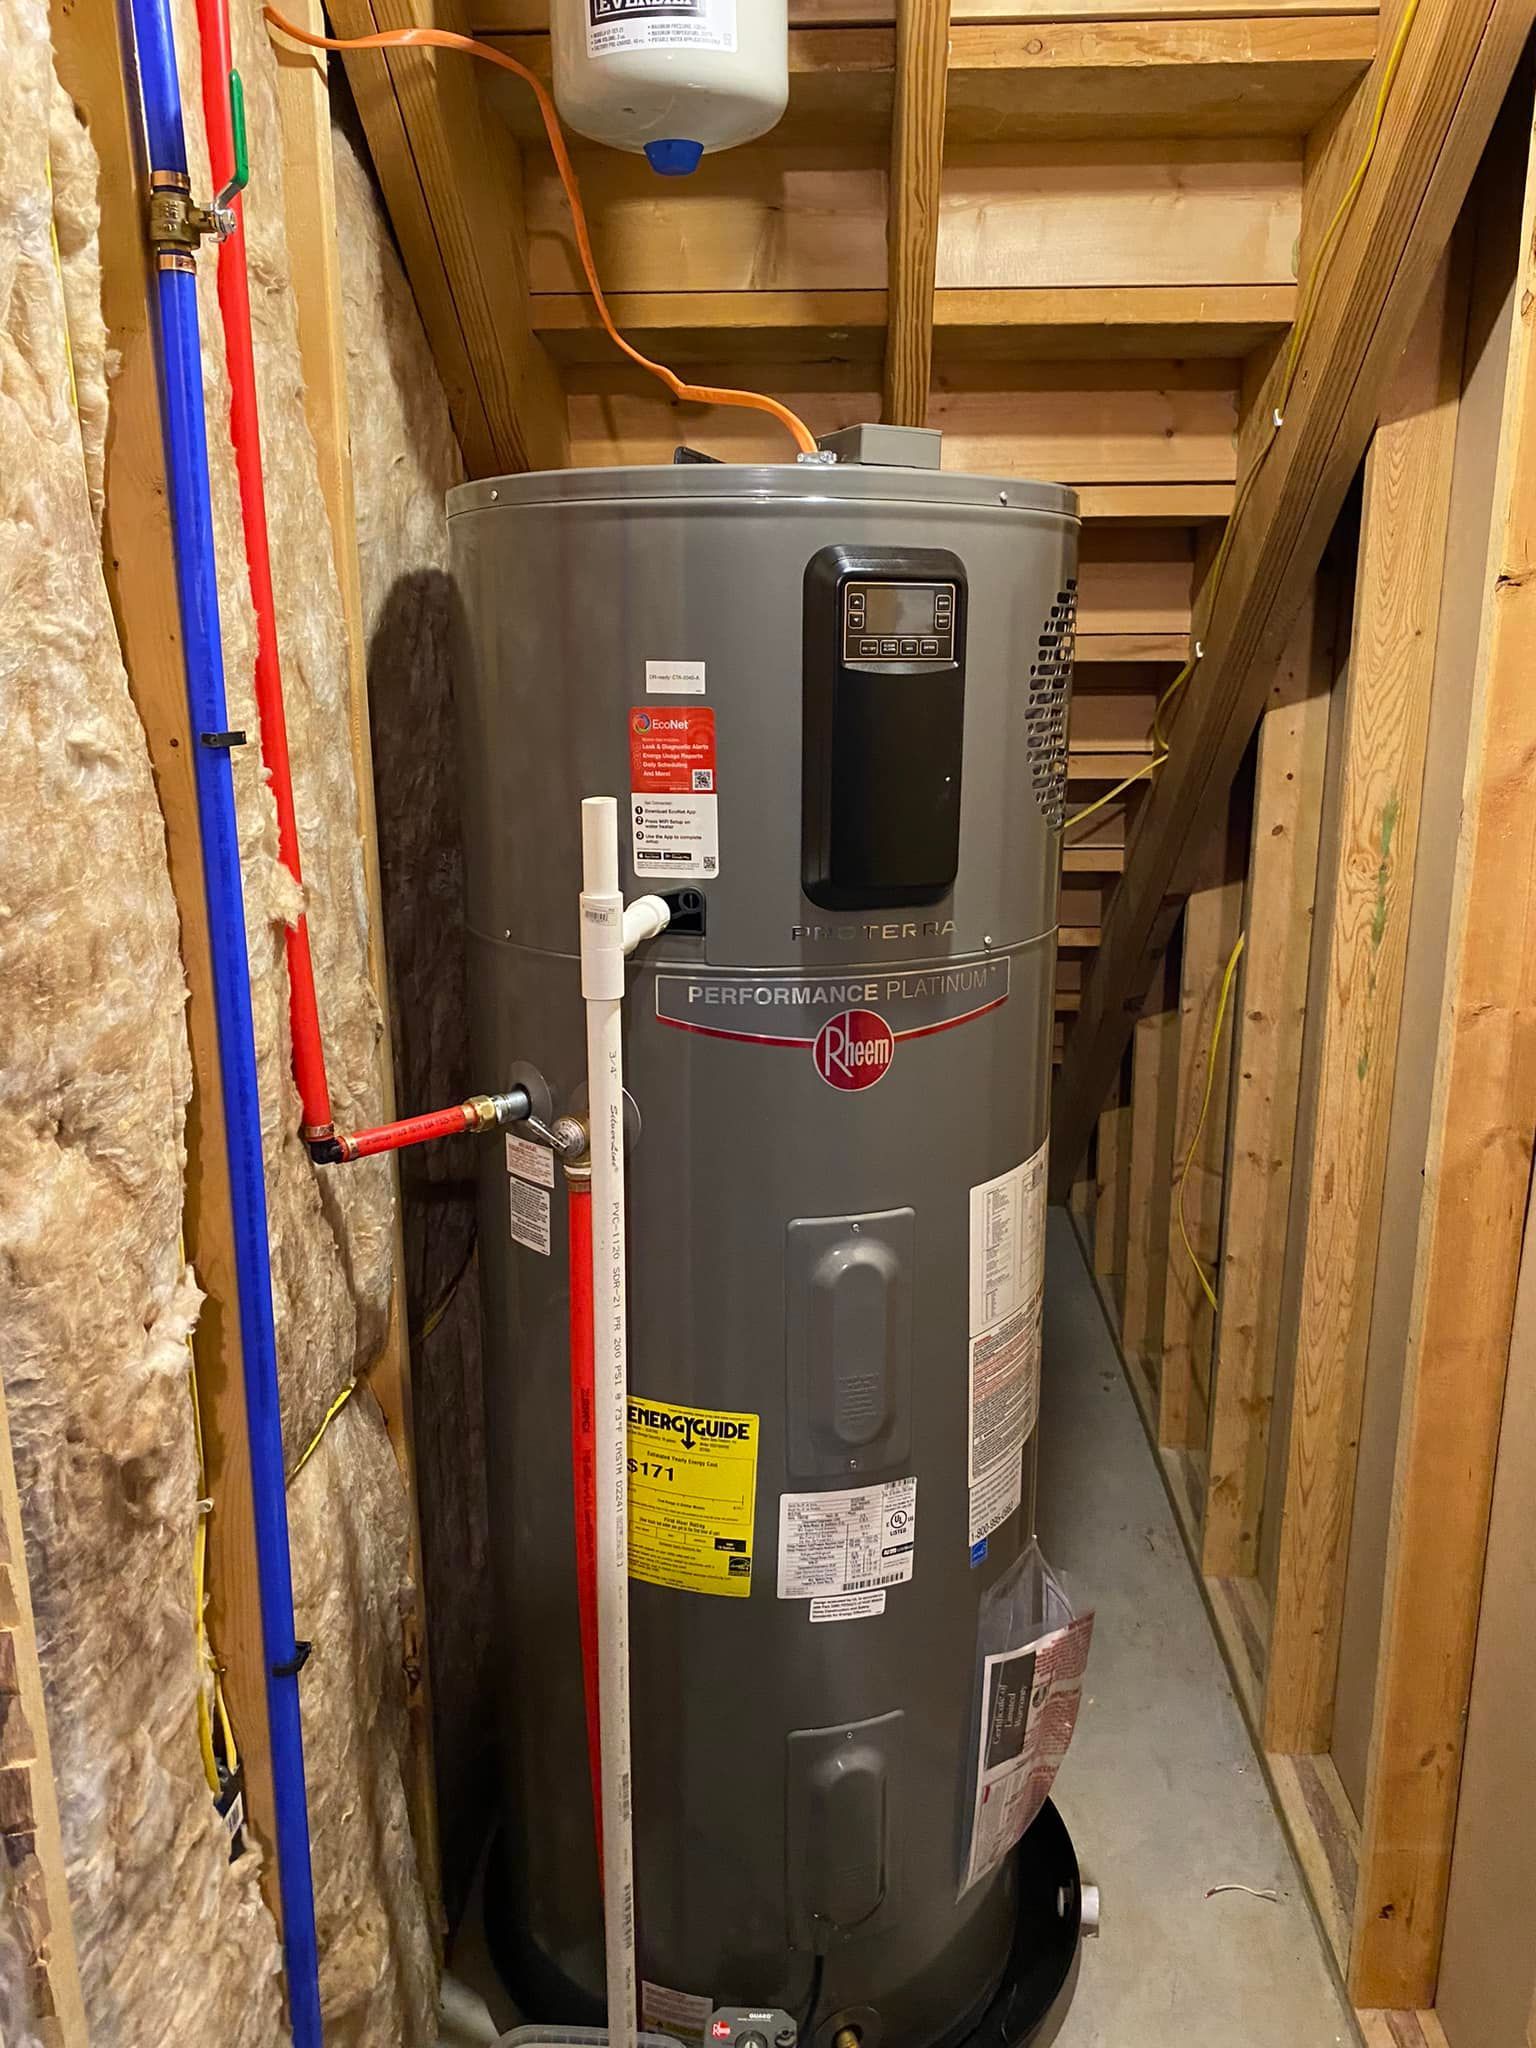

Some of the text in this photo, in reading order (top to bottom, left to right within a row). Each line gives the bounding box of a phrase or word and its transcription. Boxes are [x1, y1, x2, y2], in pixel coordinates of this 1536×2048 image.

[688, 984, 878, 1006] PERFORMANCE
[825, 1011, 890, 1078] Rheem
[614, 1338, 622, 1358] 200
[627, 1405, 750, 1441] ENERGYGUIDE
[627, 1458, 674, 1482] $171
